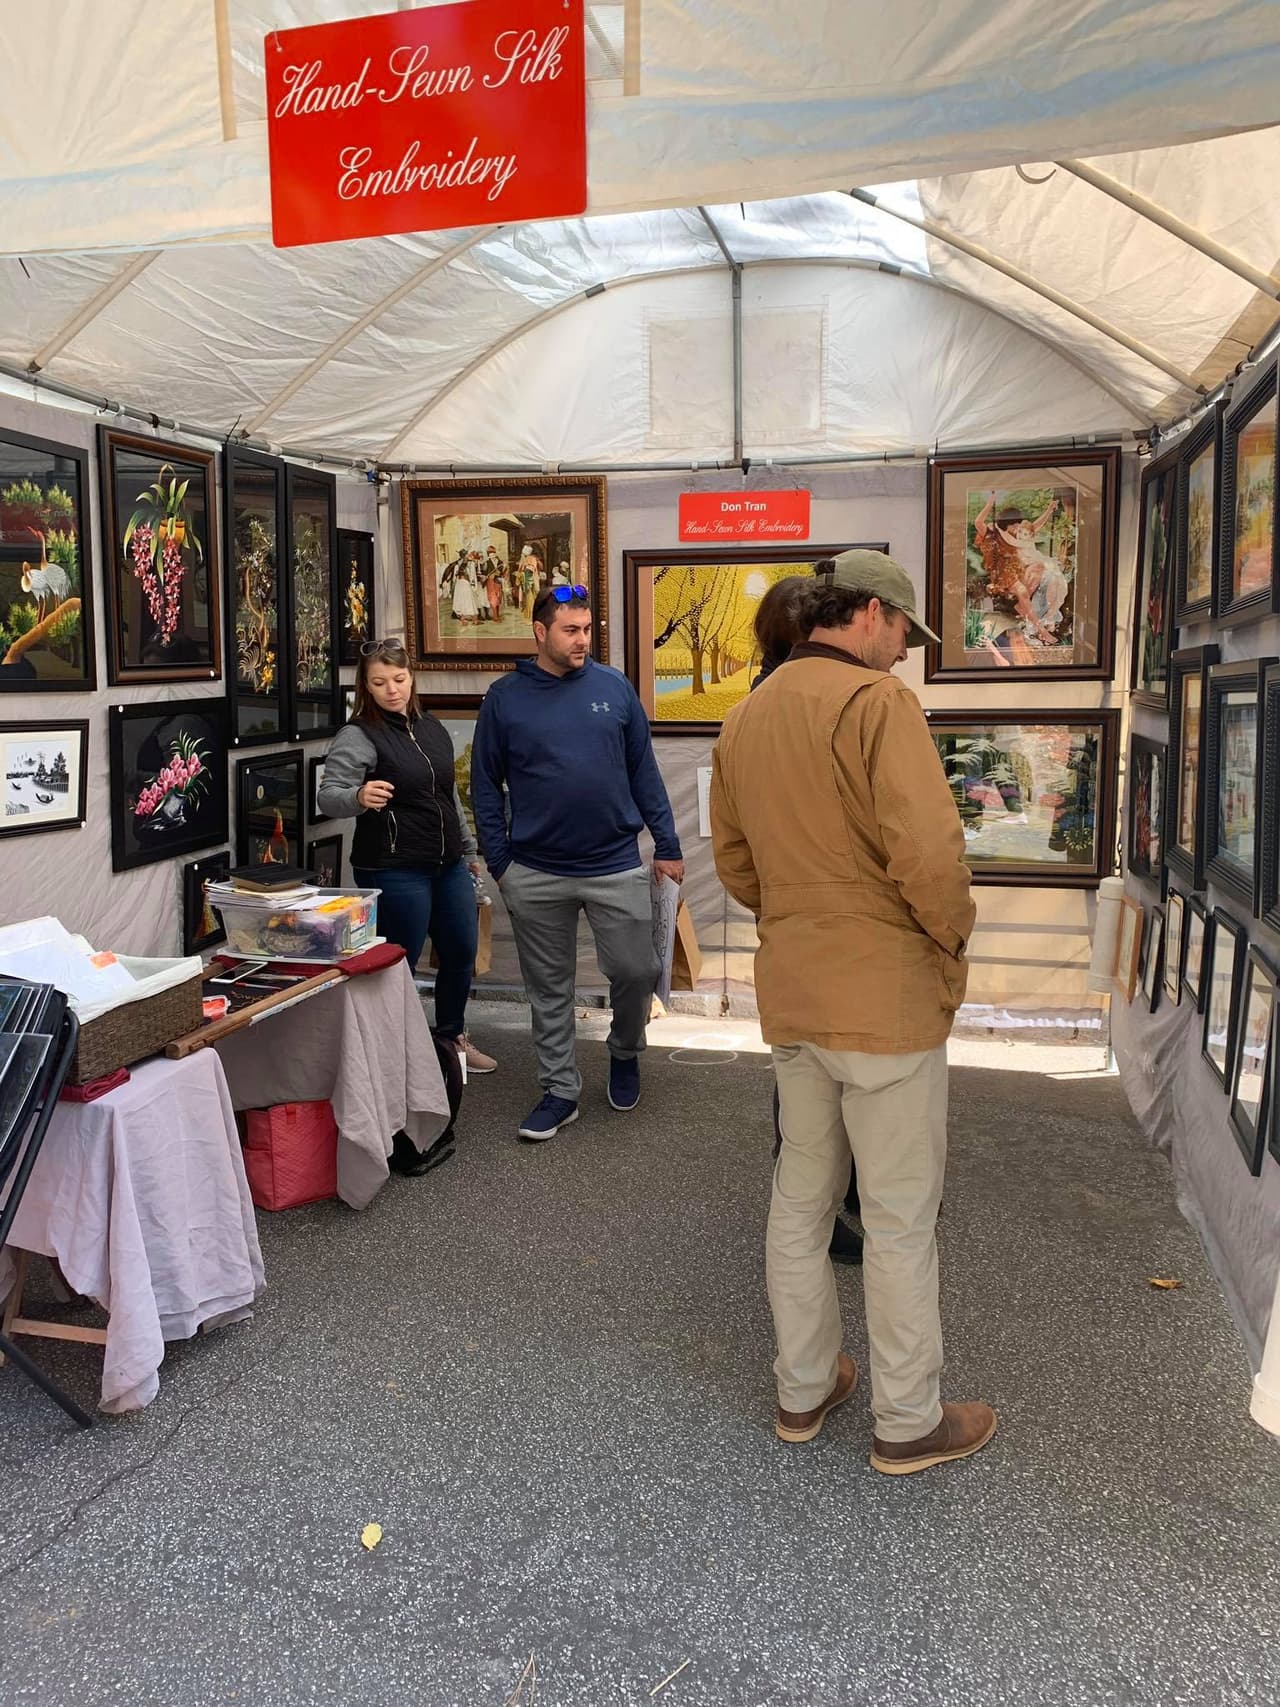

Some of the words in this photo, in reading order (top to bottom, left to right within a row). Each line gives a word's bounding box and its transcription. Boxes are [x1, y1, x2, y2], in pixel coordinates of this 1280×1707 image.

[275, 44, 474, 118] Hand-Sewn
[483, 25, 569, 88] Silk
[338, 137, 517, 201] Embroidery
[721, 502, 741, 512] Don
[744, 501, 767, 511] Tran
[685, 519, 734, 534] Hand-Sewn
[735, 519, 757, 534] Silk
[758, 518, 804, 537] Embroidery
